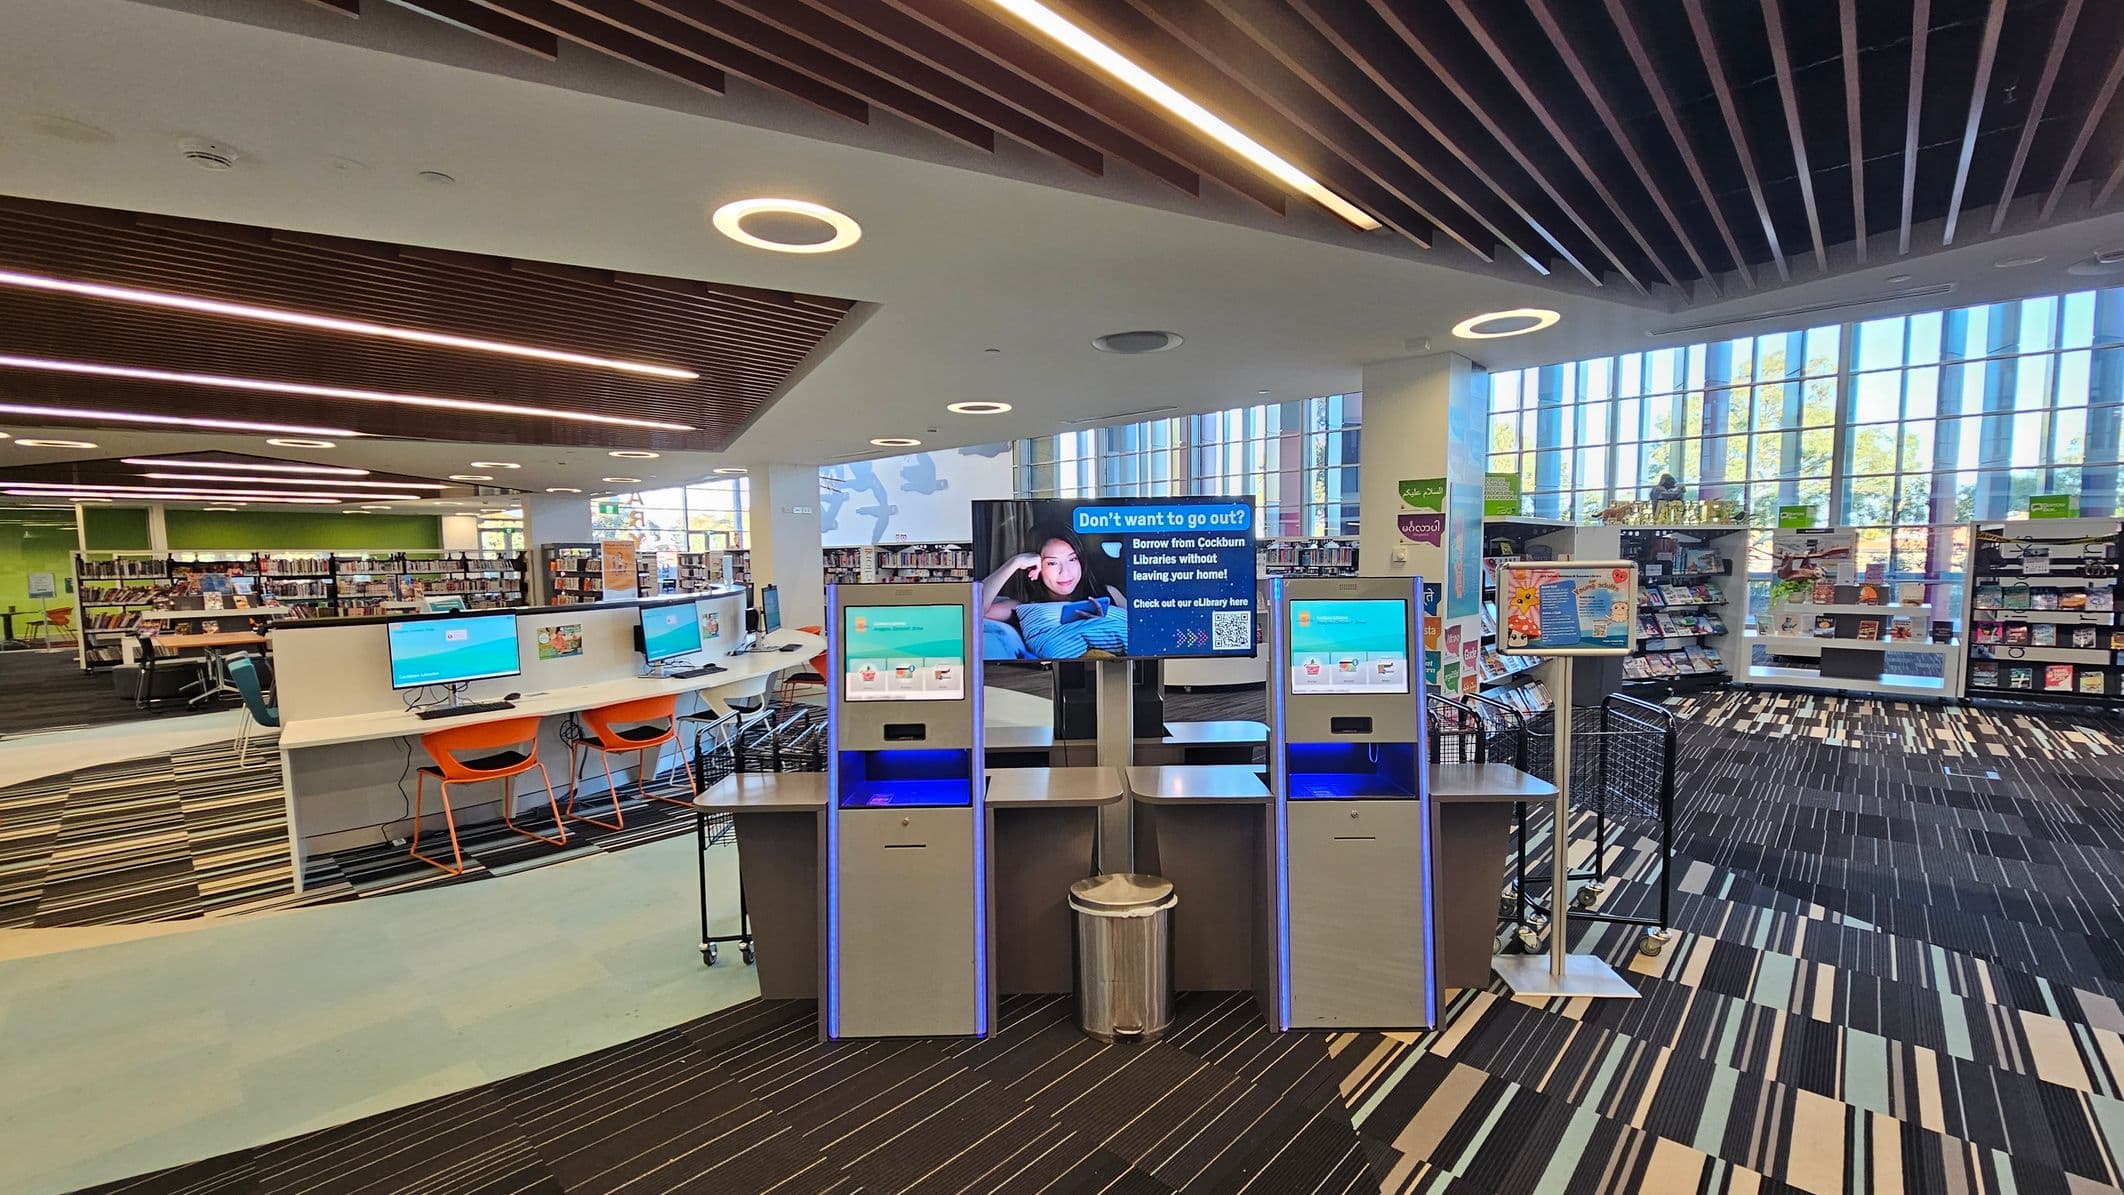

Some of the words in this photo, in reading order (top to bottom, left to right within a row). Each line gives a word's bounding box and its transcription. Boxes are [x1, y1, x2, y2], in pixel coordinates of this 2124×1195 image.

[1079, 512, 1121, 528] Don't
[1124, 512, 1164, 526] want
[1167, 511, 1184, 525] to
[1188, 513, 1206, 529] go
[1210, 510, 1245, 525] out?
[1132, 538, 1169, 549] Borrow
[1171, 537, 1195, 548] from
[1197, 536, 1246, 548] Cockburn
[1132, 554, 1177, 565] Libraries
[1178, 553, 1218, 564] without
[1132, 570, 1169, 582] leaving
[1171, 571, 1194, 583] your
[1196, 569, 1228, 580] home!
[1132, 598, 1160, 608] Check
[1162, 599, 1176, 608] out
[1177, 600, 1191, 609] our
[1193, 597, 1227, 609] eLibrary
[1229, 597, 1249, 607] here
